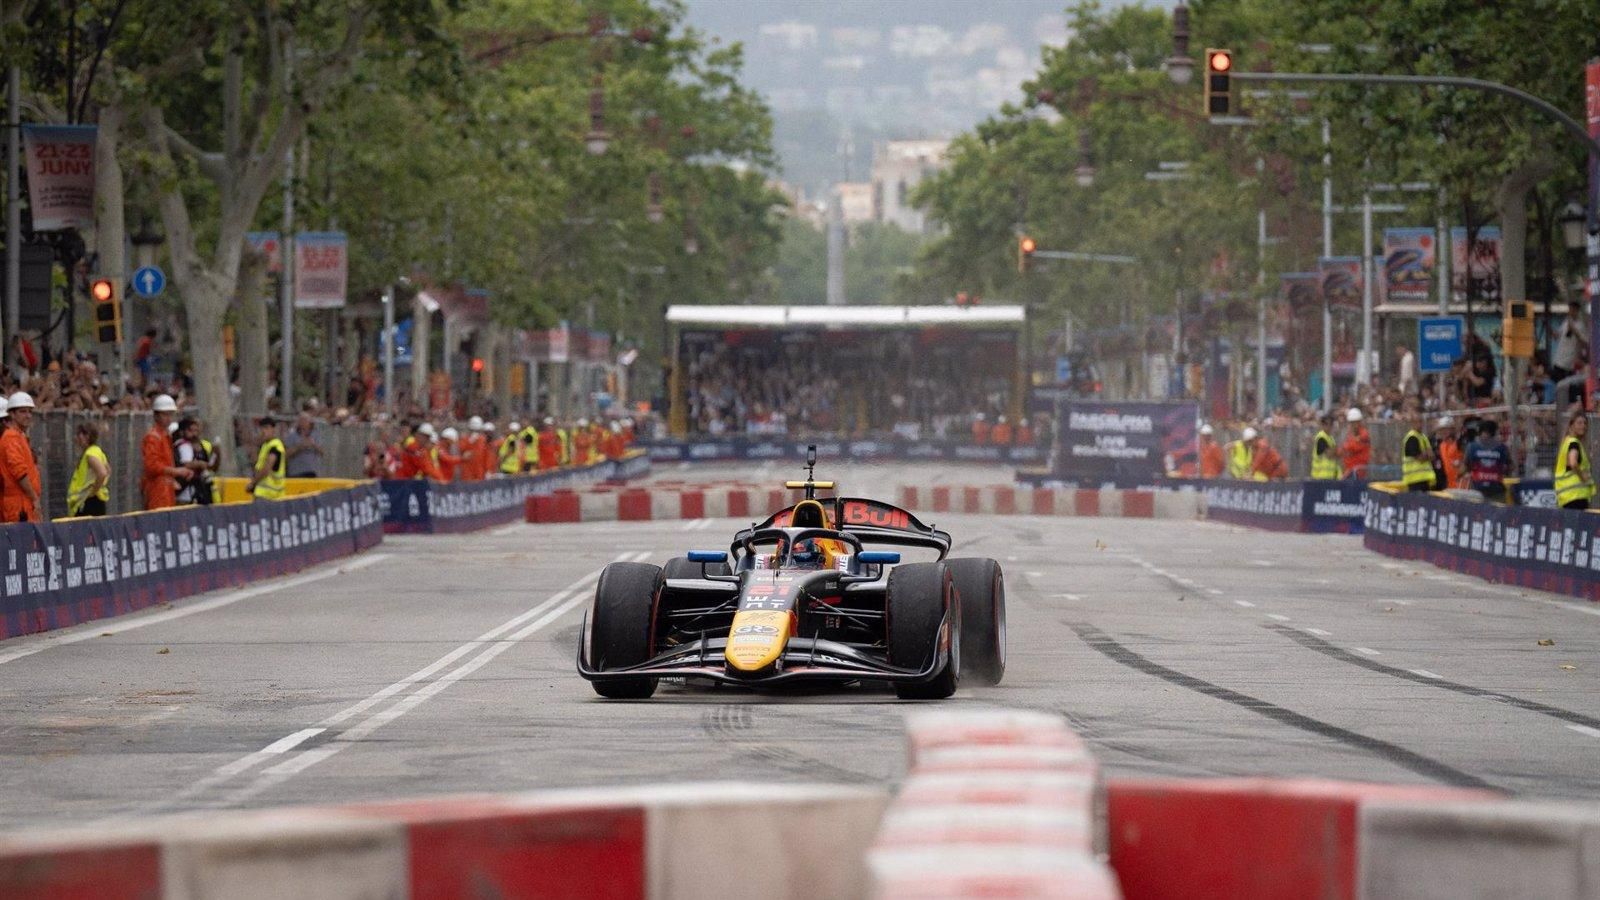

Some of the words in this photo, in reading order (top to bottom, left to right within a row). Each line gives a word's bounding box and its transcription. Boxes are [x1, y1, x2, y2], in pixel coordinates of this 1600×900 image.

[37, 160, 91, 176] JUNY
[844, 501, 909, 529] Bull
[748, 585, 790, 597] 21
